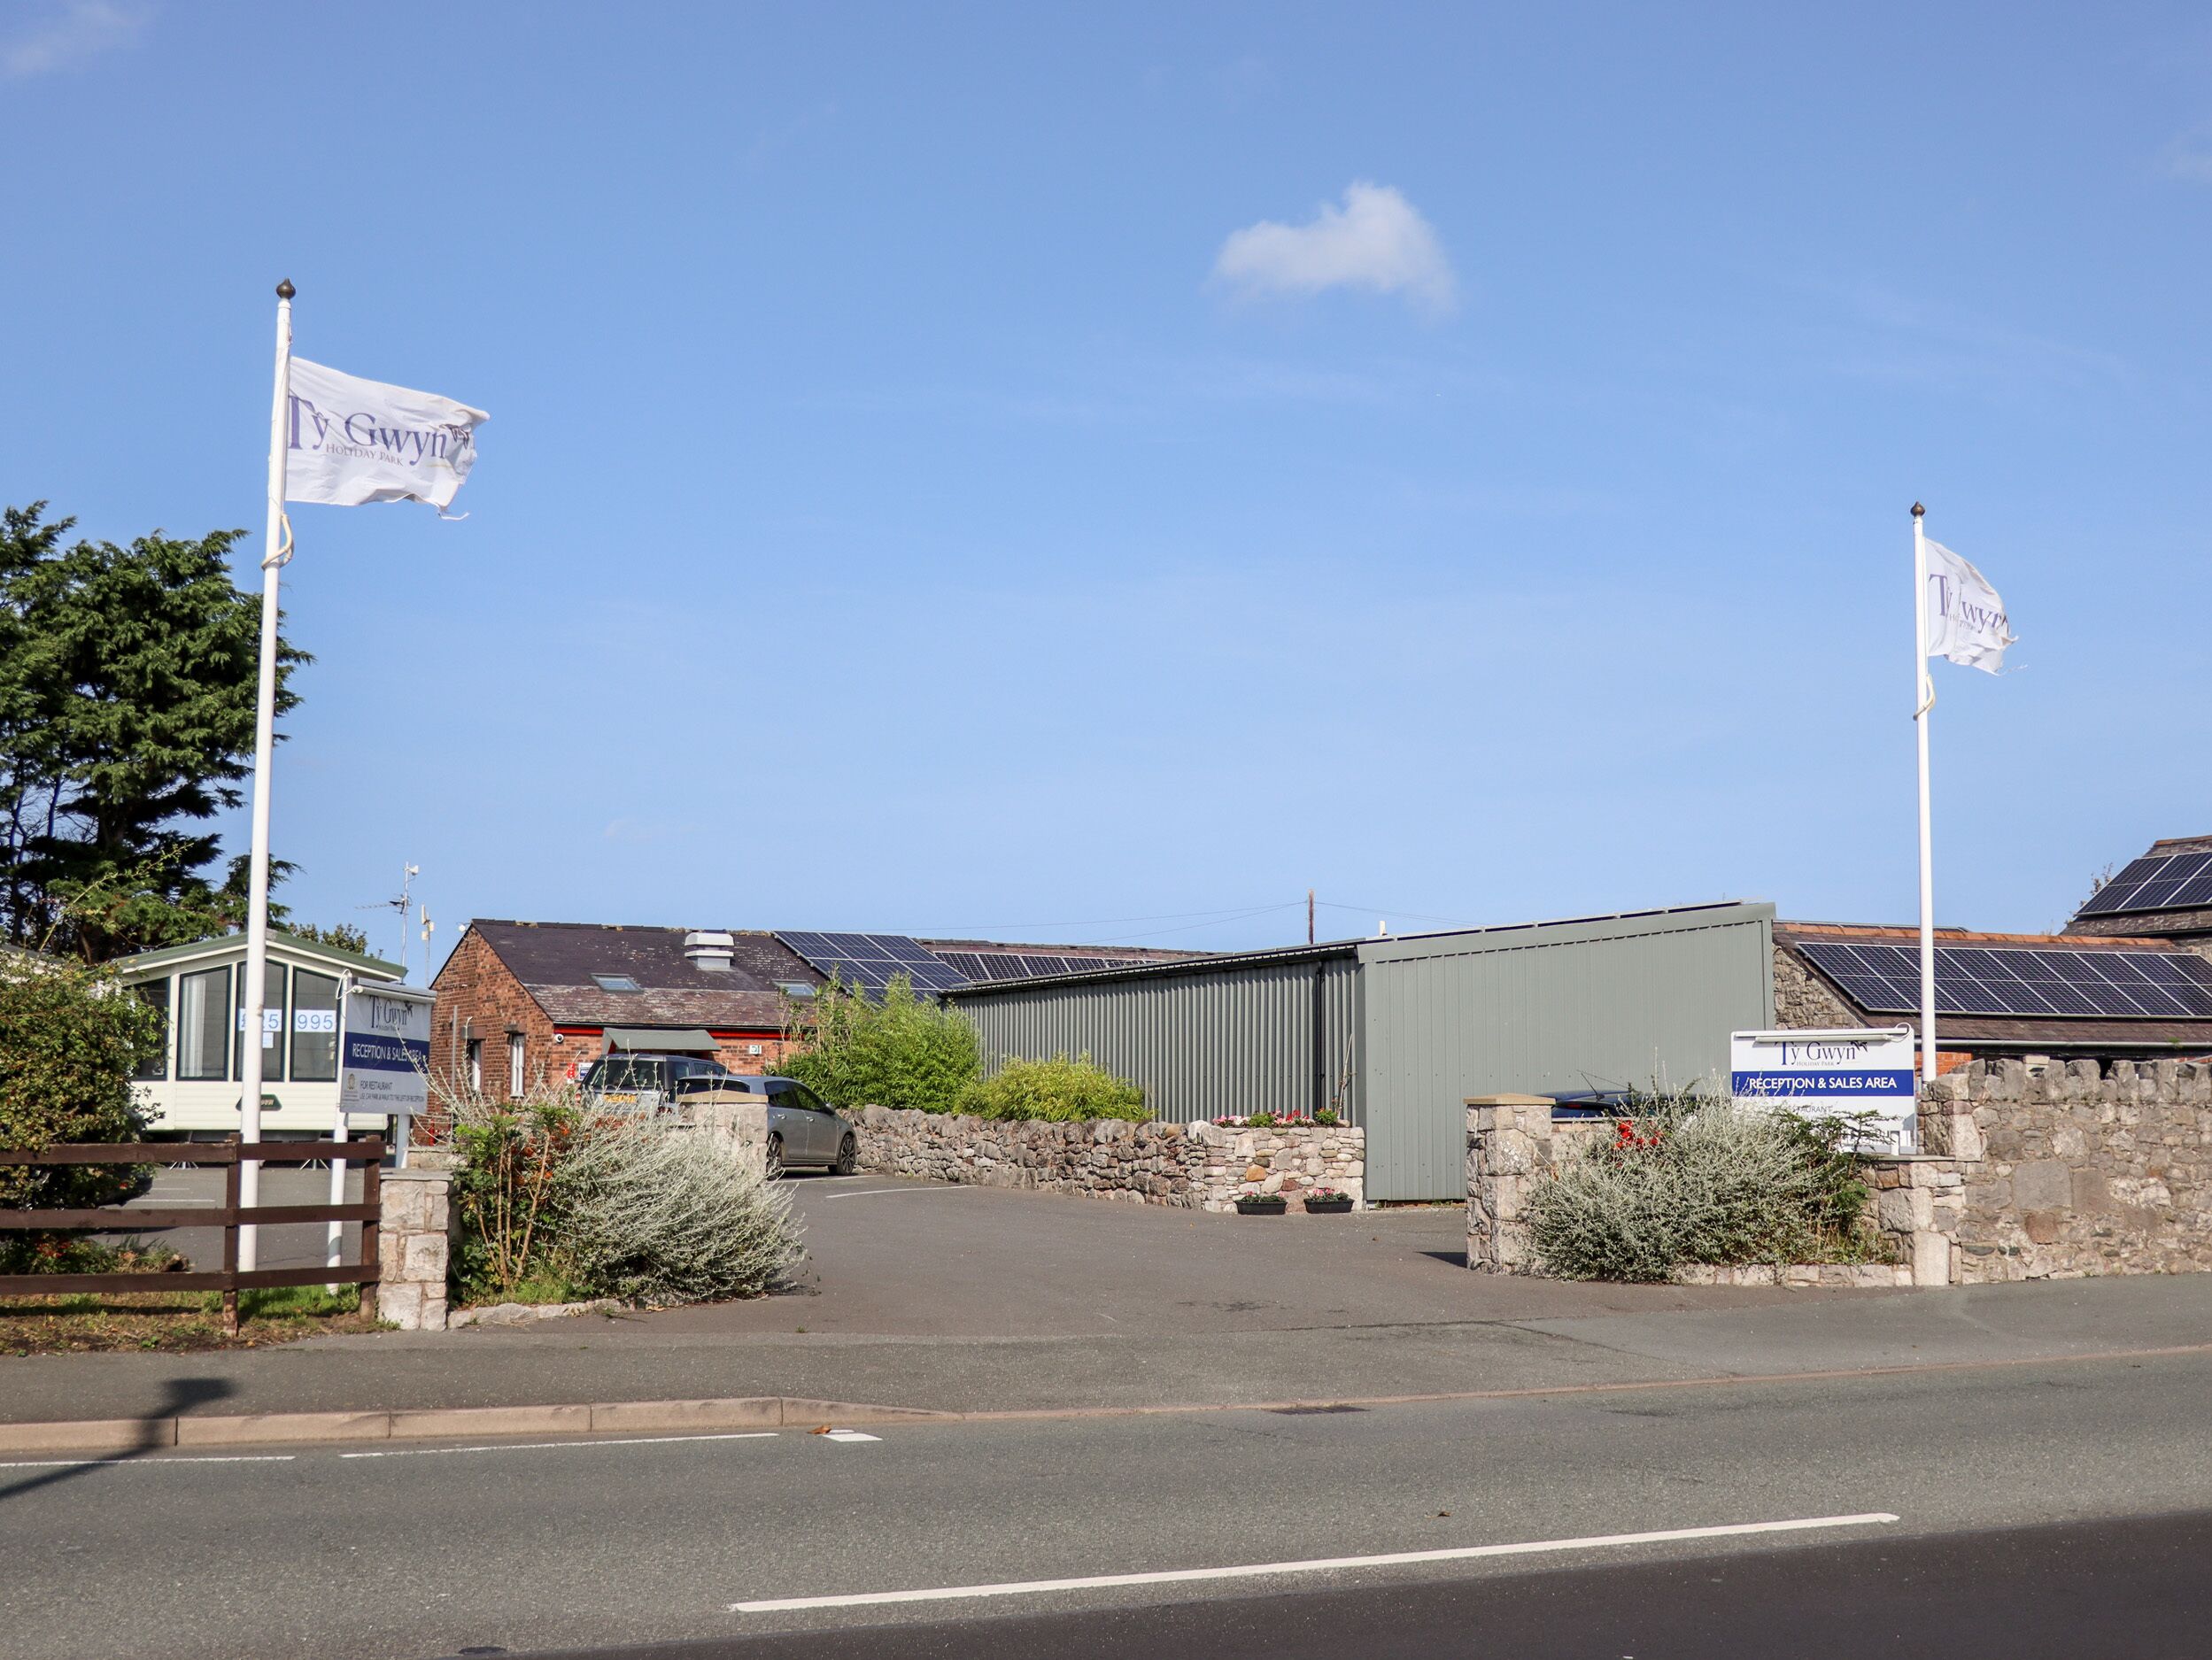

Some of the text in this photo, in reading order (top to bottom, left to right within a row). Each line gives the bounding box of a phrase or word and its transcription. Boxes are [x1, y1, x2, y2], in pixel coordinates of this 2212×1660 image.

[344, 412, 447, 467] Gwyn
[326, 444, 404, 467] HOLIDAY PARK
[298, 1014, 334, 1030] 995
[352, 1043, 387, 1061] RECEPTION
[387, 1046, 391, 1061] &
[1806, 1040, 1856, 1065] Gwyn
[1749, 1077, 1898, 1089] RECEPTION & SALES AREA
